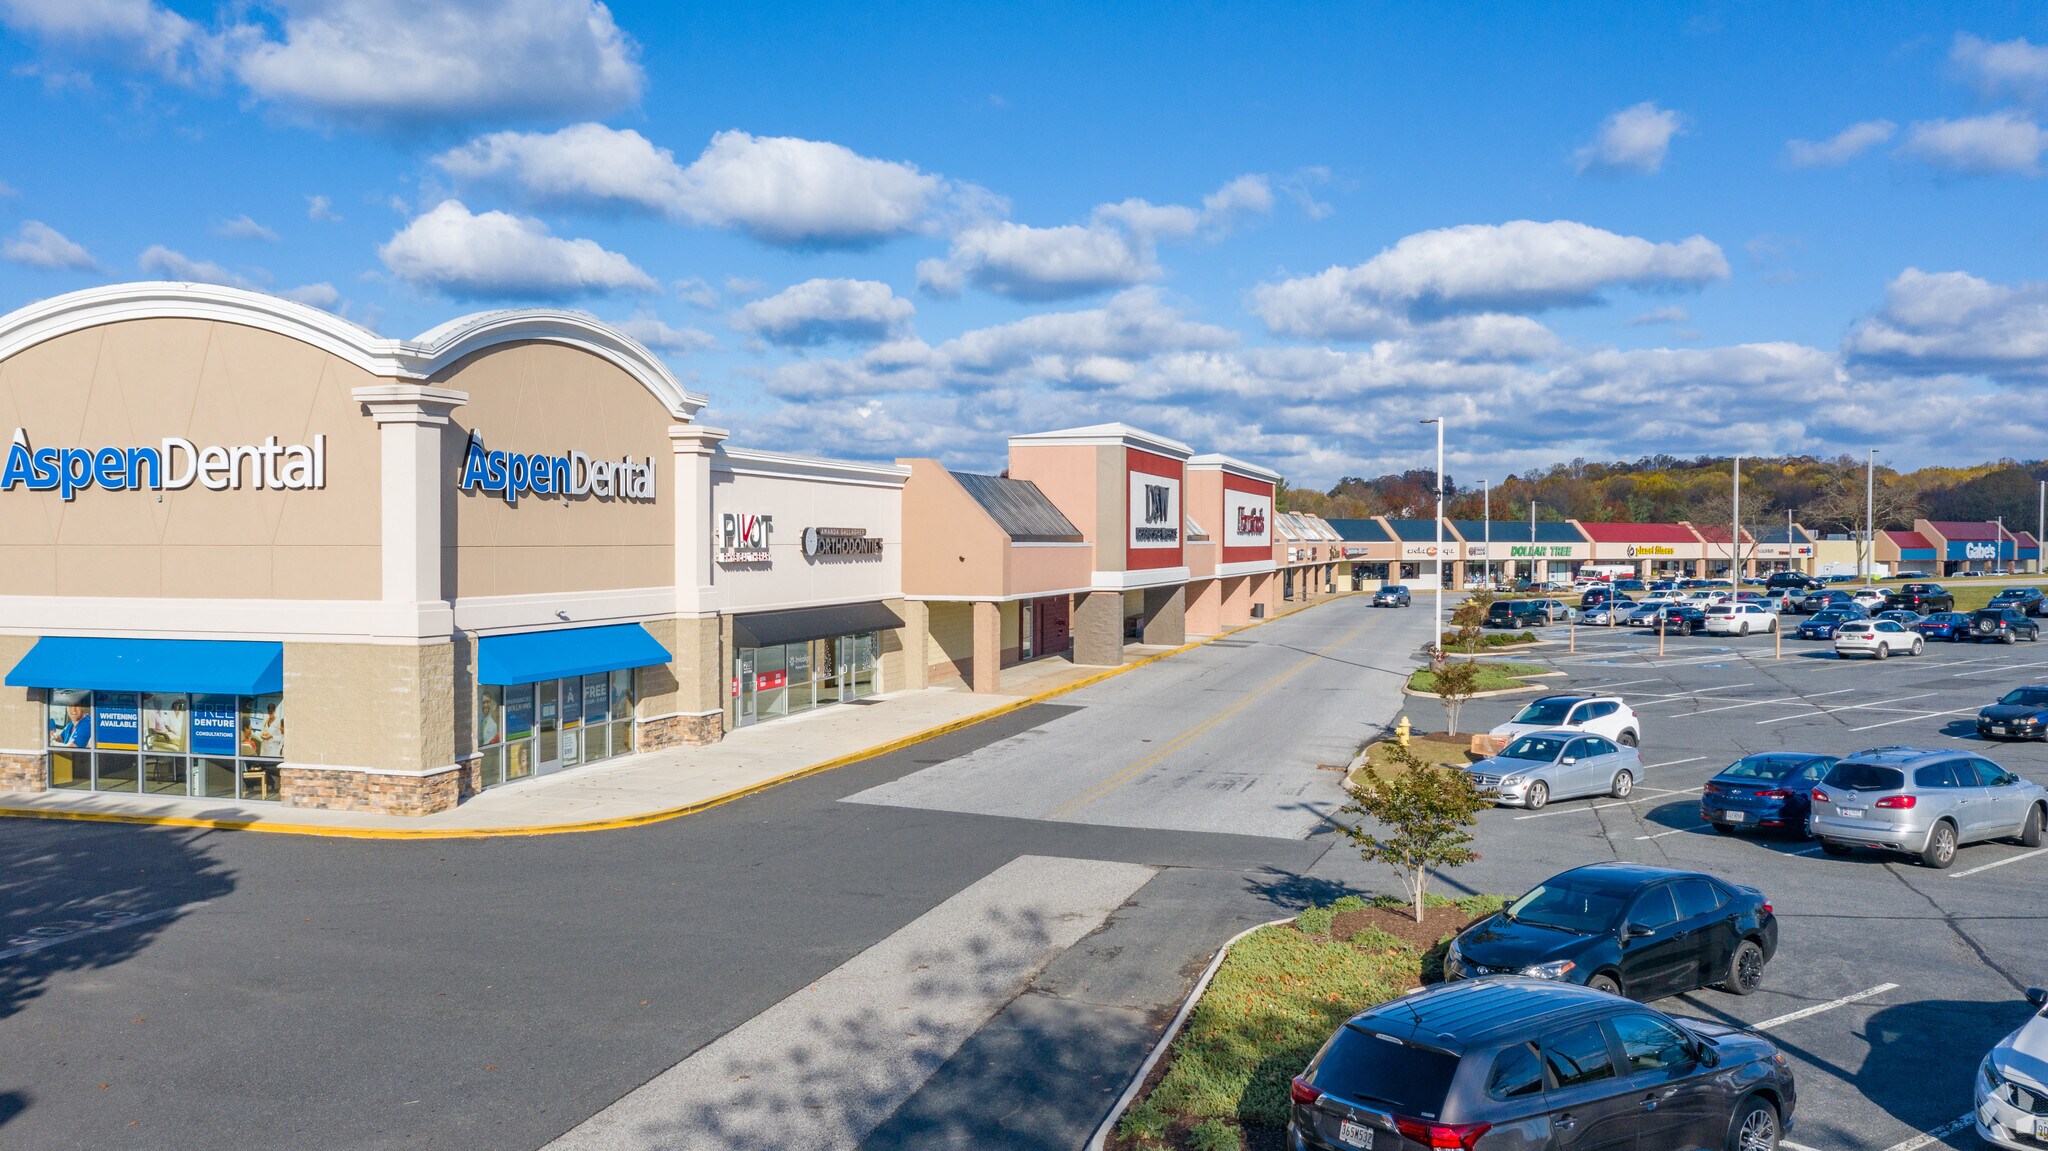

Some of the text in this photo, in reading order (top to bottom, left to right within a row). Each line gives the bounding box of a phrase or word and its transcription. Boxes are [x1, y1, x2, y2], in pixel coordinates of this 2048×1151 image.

[720, 513, 773, 549] PIVOT
[817, 537, 883, 555] ORTHODONTICS
[1511, 546, 1572, 556] DOLLAR TREE
[1966, 542, 1995, 558] Gabe's
[584, 684, 606, 698] FREE
[100, 712, 137, 721] WHITENING
[194, 702, 235, 719] FREE
[100, 720, 137, 728] AVAILABLE
[194, 718, 235, 728] DENTURE
[195, 730, 234, 738] CONSULTATIONS
